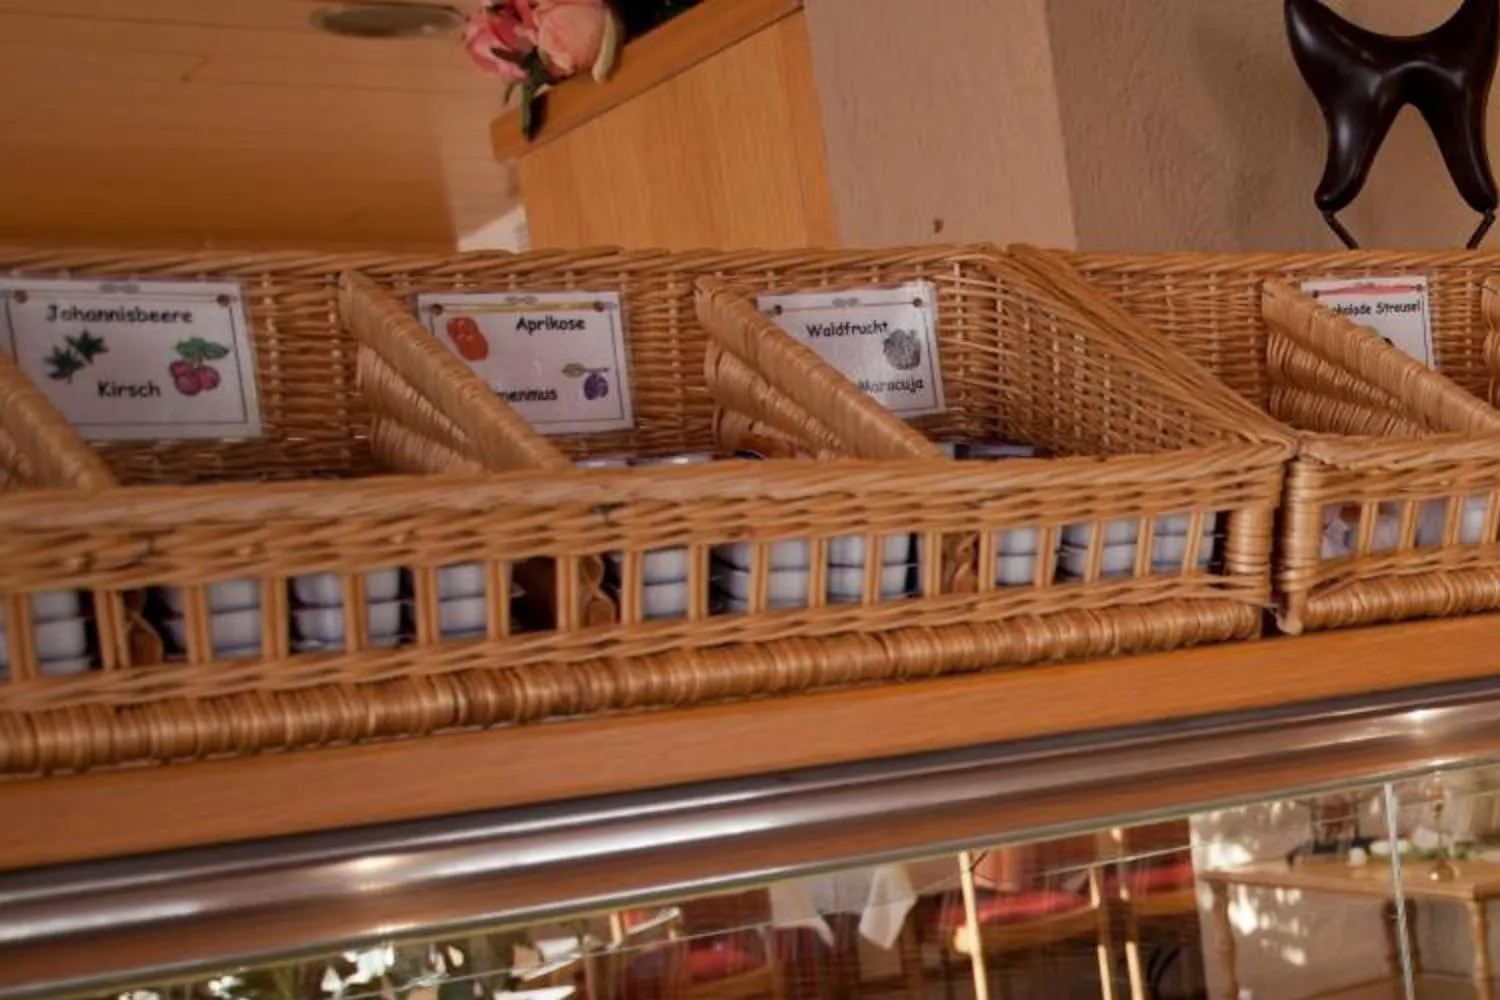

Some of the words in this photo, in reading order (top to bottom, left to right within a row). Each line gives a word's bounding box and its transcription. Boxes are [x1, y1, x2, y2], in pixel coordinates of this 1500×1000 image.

[45, 304, 193, 323] Johannisbeere
[516, 315, 586, 336] Aprikose
[805, 320, 888, 337] Waldfrucht
[96, 380, 161, 397] Kirsch
